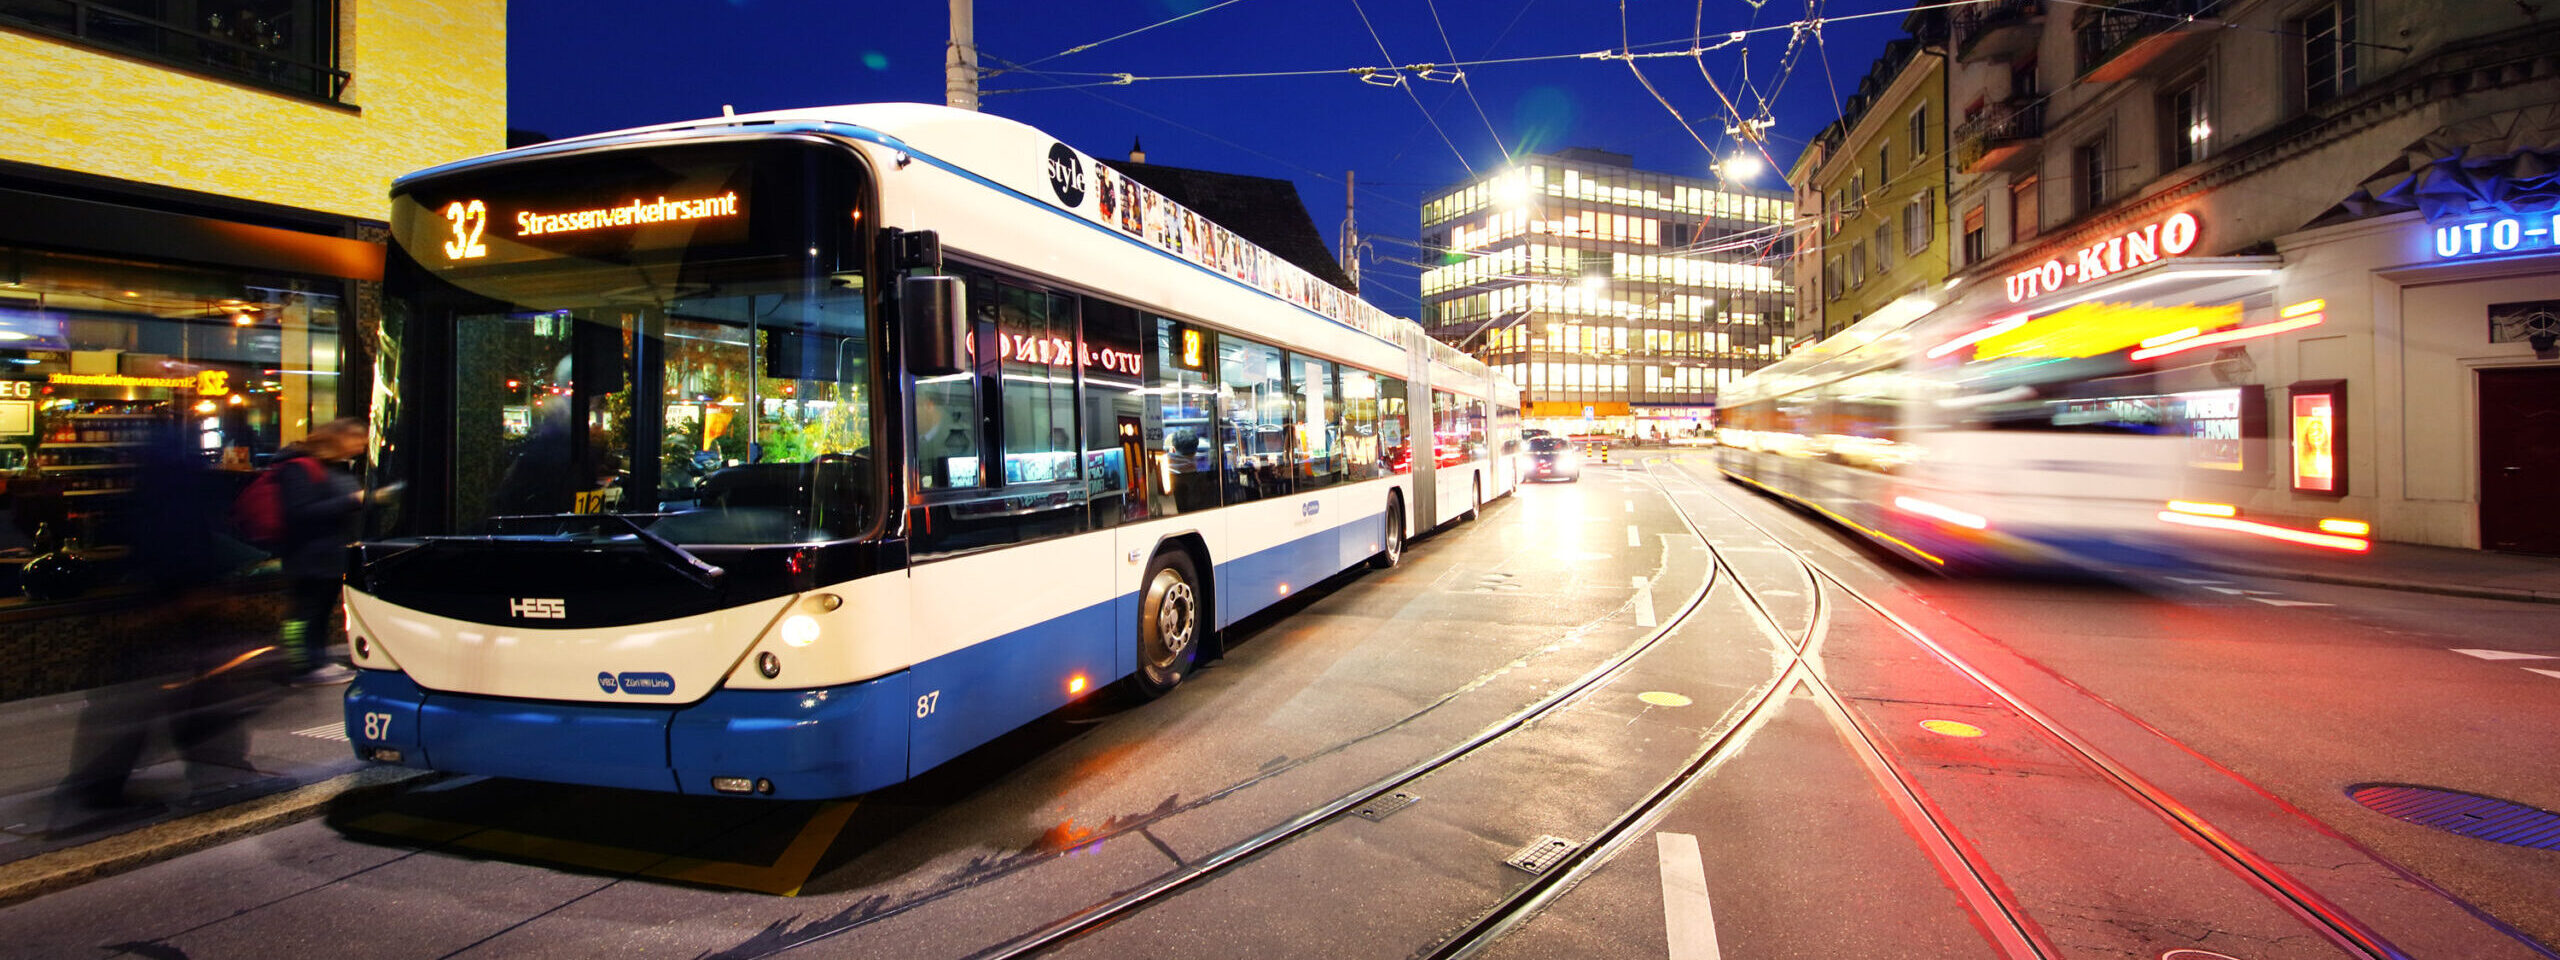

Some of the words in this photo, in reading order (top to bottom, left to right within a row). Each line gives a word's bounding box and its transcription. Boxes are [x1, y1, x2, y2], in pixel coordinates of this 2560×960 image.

[1048, 157, 1085, 194] style
[444, 200, 486, 260] 32
[517, 192, 737, 236] Strassenverkehrsamt
[510, 598, 566, 619] HESS
[600, 678, 616, 687] VBZ
[651, 679, 670, 688] Linie
[916, 690, 940, 719] 87
[364, 711, 392, 740] 87
